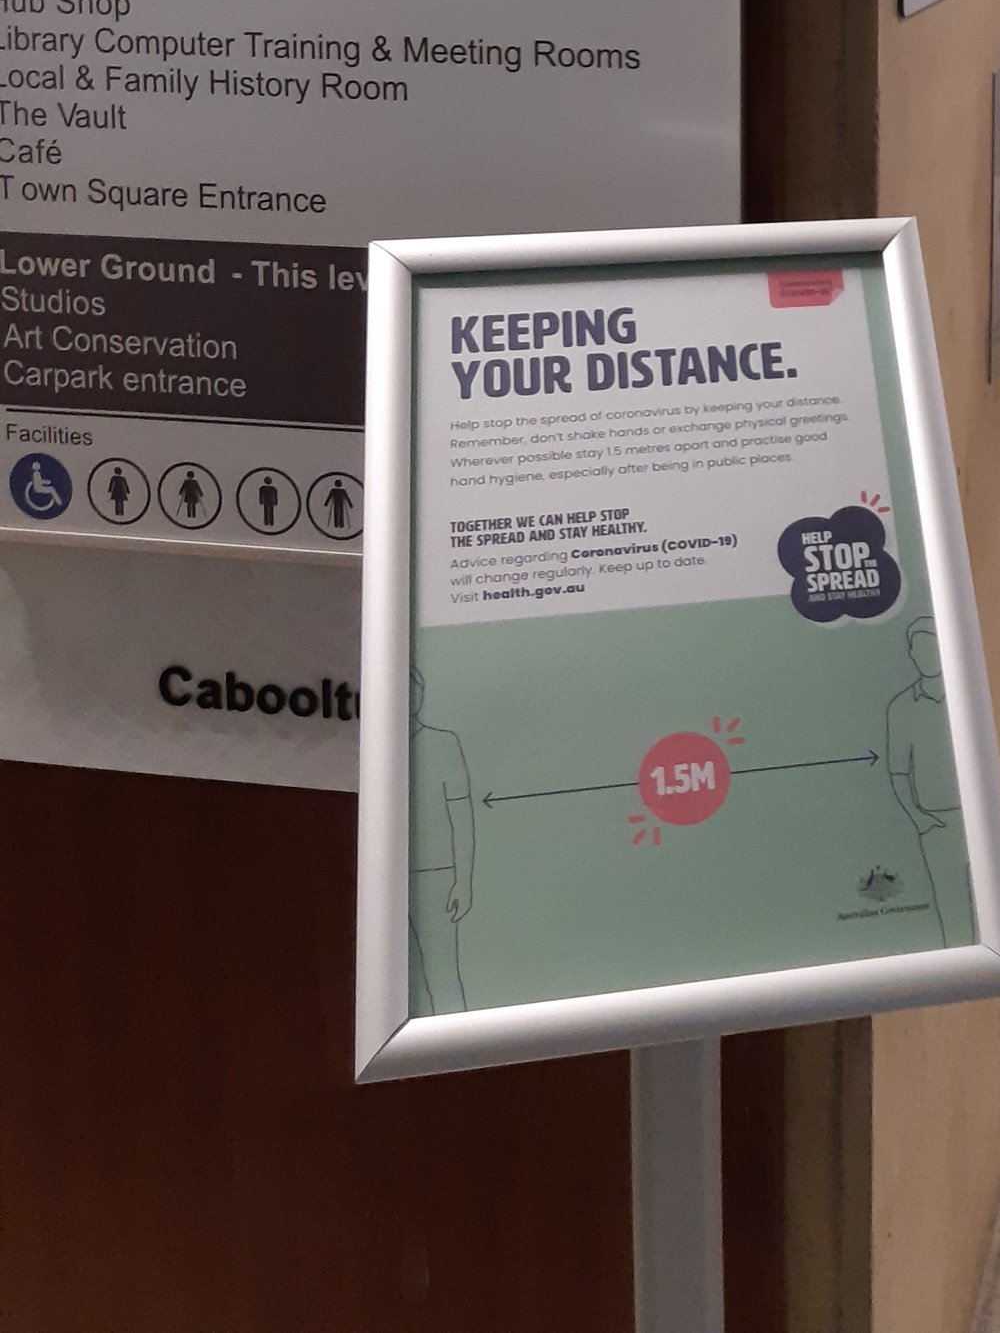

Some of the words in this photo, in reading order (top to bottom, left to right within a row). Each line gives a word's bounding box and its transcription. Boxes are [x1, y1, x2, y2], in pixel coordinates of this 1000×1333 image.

[95, 27, 235, 61] Computer
[244, 32, 360, 67] Training
[371, 35, 392, 62] &
[404, 36, 521, 72] Meeting
[534, 40, 641, 69] Rooms
[76, 65, 94, 91] &
[106, 67, 199, 101] Family
[210, 69, 310, 104] History
[322, 72, 408, 101] Room
[58, 102, 126, 130] Vault
[88, 178, 188, 211] Square
[200, 183, 326, 213] Entrance
[0, 249, 90, 278] Lower
[101, 254, 215, 284] Ground
[250, 261, 318, 290] This
[330, 264, 369, 291] lev
[1, 286, 106, 316] Studios
[3, 323, 43, 350] Art
[52, 326, 238, 360] Conservation
[452, 307, 637, 354] KEEPING
[3, 360, 114, 393] Carpark
[123, 372, 247, 398] entrance
[452, 355, 572, 400] YOUR
[587, 342, 798, 391] DISTANCE.
[451, 419, 480, 431] Help
[484, 416, 512, 429] stop
[516, 415, 537, 427] the
[541, 411, 587, 427] spread
[591, 410, 603, 421] of
[606, 405, 681, 420] coronavirus
[685, 405, 699, 417] by
[703, 400, 753, 414] keeping
[756, 399, 783, 411] your
[451, 434, 526, 449] Remember,
[531, 431, 564, 445] don't
[568, 428, 606, 441] shake
[609, 426, 650, 439] hands
[653, 425, 665, 435] or
[669, 420, 731, 435] exchange
[735, 415, 787, 430] physical
[6, 424, 93, 446] Facilities
[451, 454, 513, 468] Wherever
[518, 451, 572, 466] possible
[576, 448, 603, 461] stay
[626, 442, 671, 454] metres
[675, 439, 709, 452] apart
[713, 437, 738, 449] and
[741, 434, 791, 449] practise
[796, 430, 828, 445] good
[451, 473, 485, 487] hand
[549, 464, 614, 481] especially
[619, 462, 648, 475] after
[652, 459, 689, 473] being
[693, 458, 704, 469] in
[708, 454, 746, 470] public
[450, 517, 512, 533] TOGETHER
[516, 515, 535, 528] WE
[539, 513, 563, 527] CAN
[567, 510, 597, 524] HELP
[600, 507, 630, 522] STOP
[450, 534, 473, 548] THE
[476, 530, 525, 547] SPREAD
[529, 528, 555, 542] AND
[559, 526, 588, 540] STAY
[592, 521, 647, 537] HEALTHY.
[451, 556, 497, 569] Advice
[501, 550, 568, 567] regarding
[571, 543, 659, 559] Coronavirus
[661, 534, 738, 554] (COVID-19)
[801, 530, 832, 545] HELP
[451, 575, 472, 586] will
[475, 569, 529, 584] change
[532, 564, 595, 582] regularly.
[599, 562, 632, 575] Keep
[636, 560, 654, 572] up
[657, 556, 671, 568] to
[803, 542, 870, 572] STOP
[450, 591, 479, 604] Visit
[482, 583, 585, 600] health.gov.au
[806, 568, 880, 592] SPREAD
[158, 665, 361, 721] Caboolt
[650, 760, 716, 796] 1.5M
